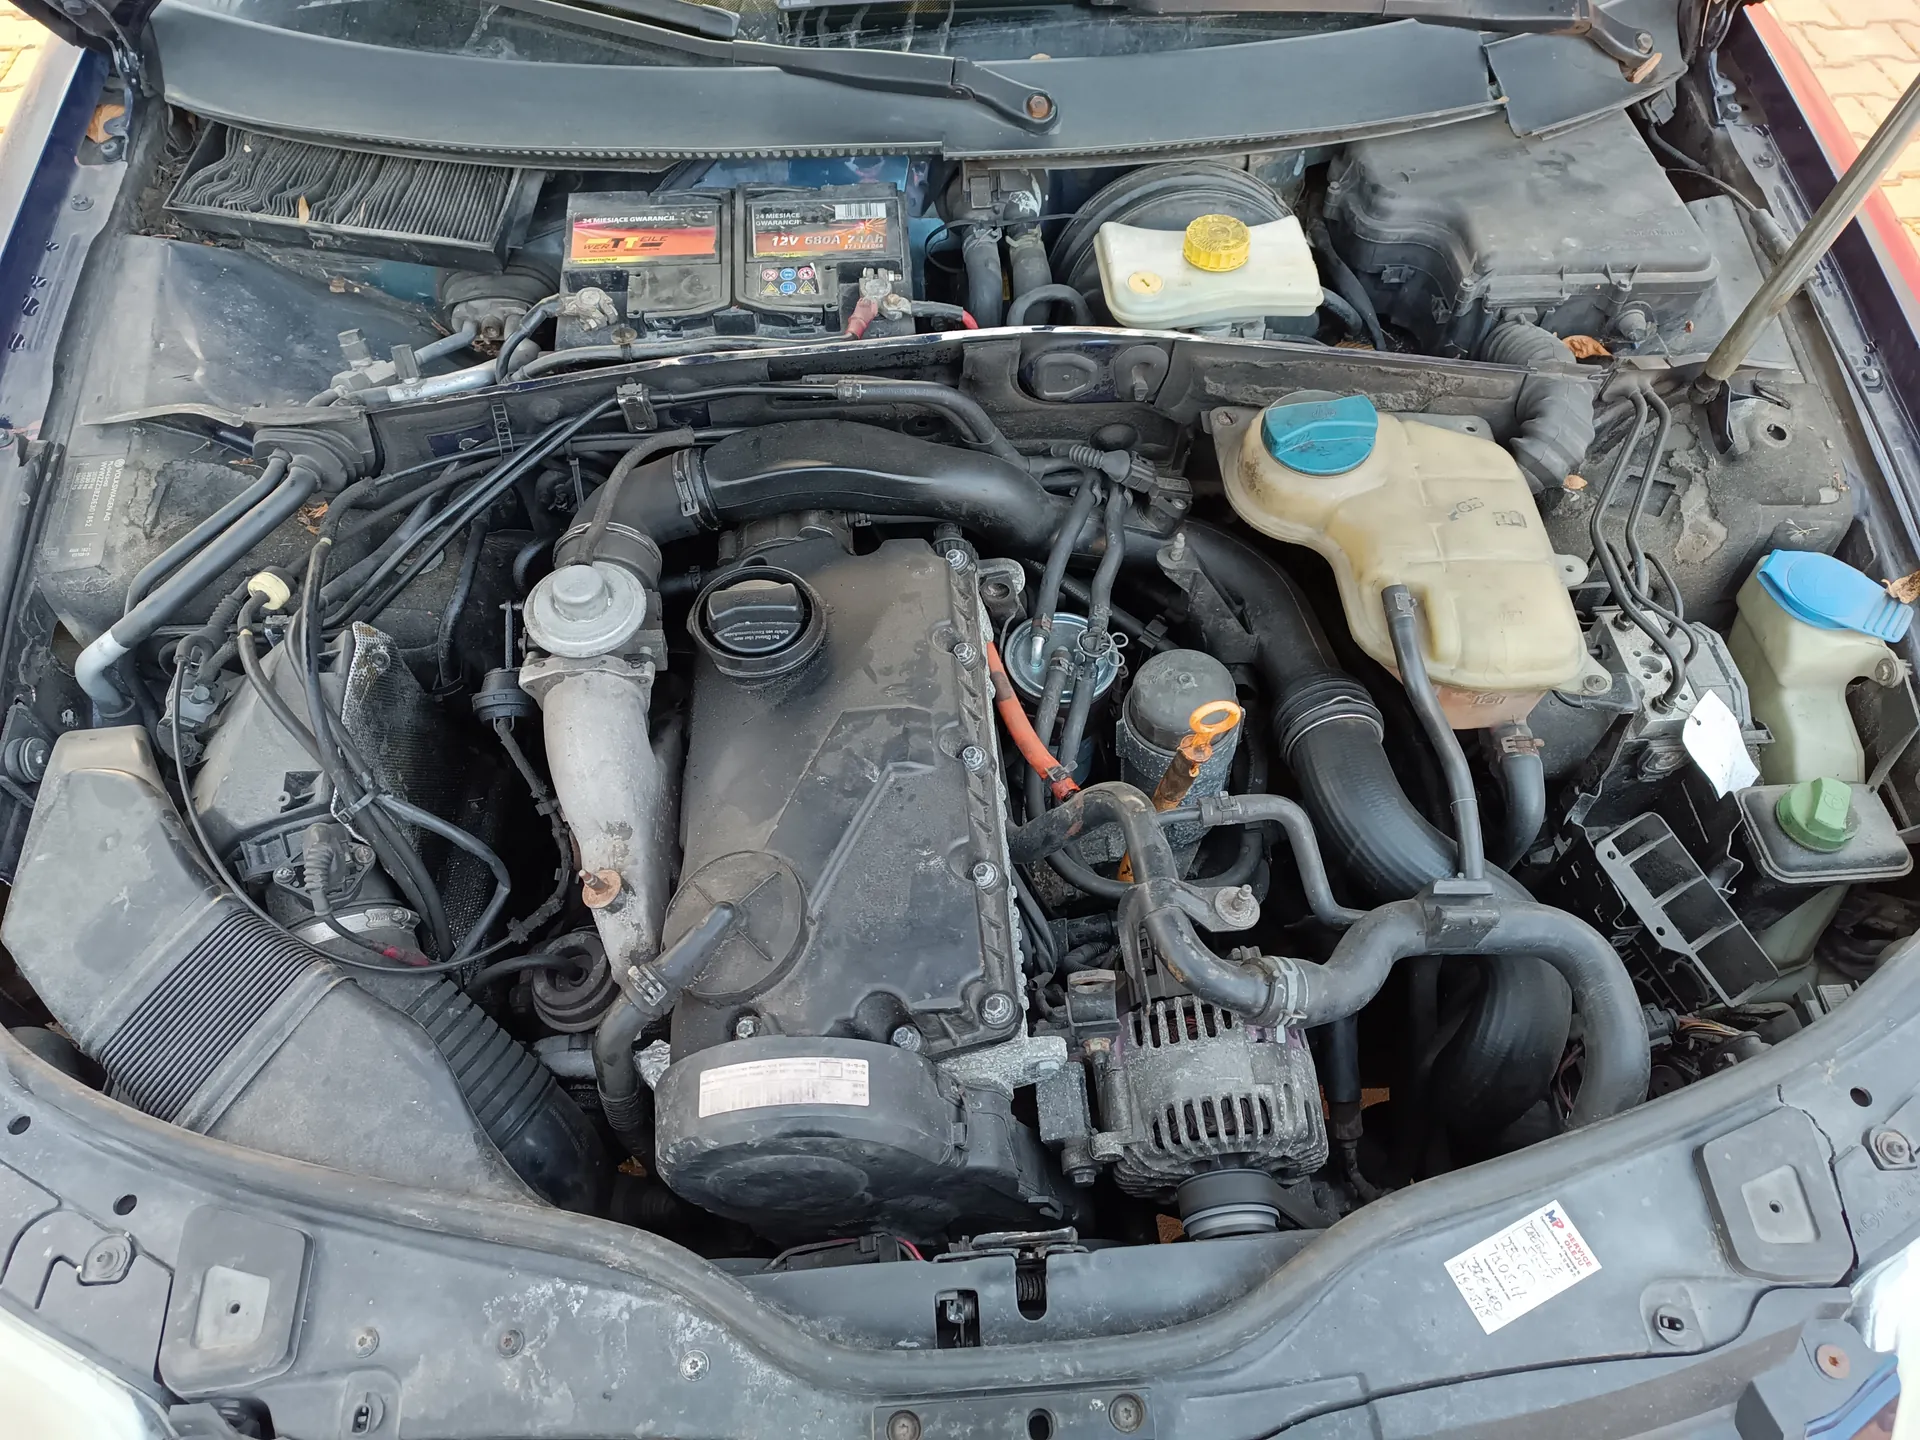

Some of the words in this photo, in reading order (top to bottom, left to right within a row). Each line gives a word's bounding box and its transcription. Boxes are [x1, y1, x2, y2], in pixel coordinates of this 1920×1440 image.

[594, 216, 629, 225] MIESIĄCE
[630, 215, 676, 223] GWARANCJI
[772, 235, 800, 247] 12V
[804, 235, 841, 245] 680A
[106, 468, 123, 512] VOLKSWAGEN
[103, 511, 112, 522] AG
[1564, 1239, 1585, 1267] OLEJU
[1566, 1232, 1592, 1268] SERVICE
